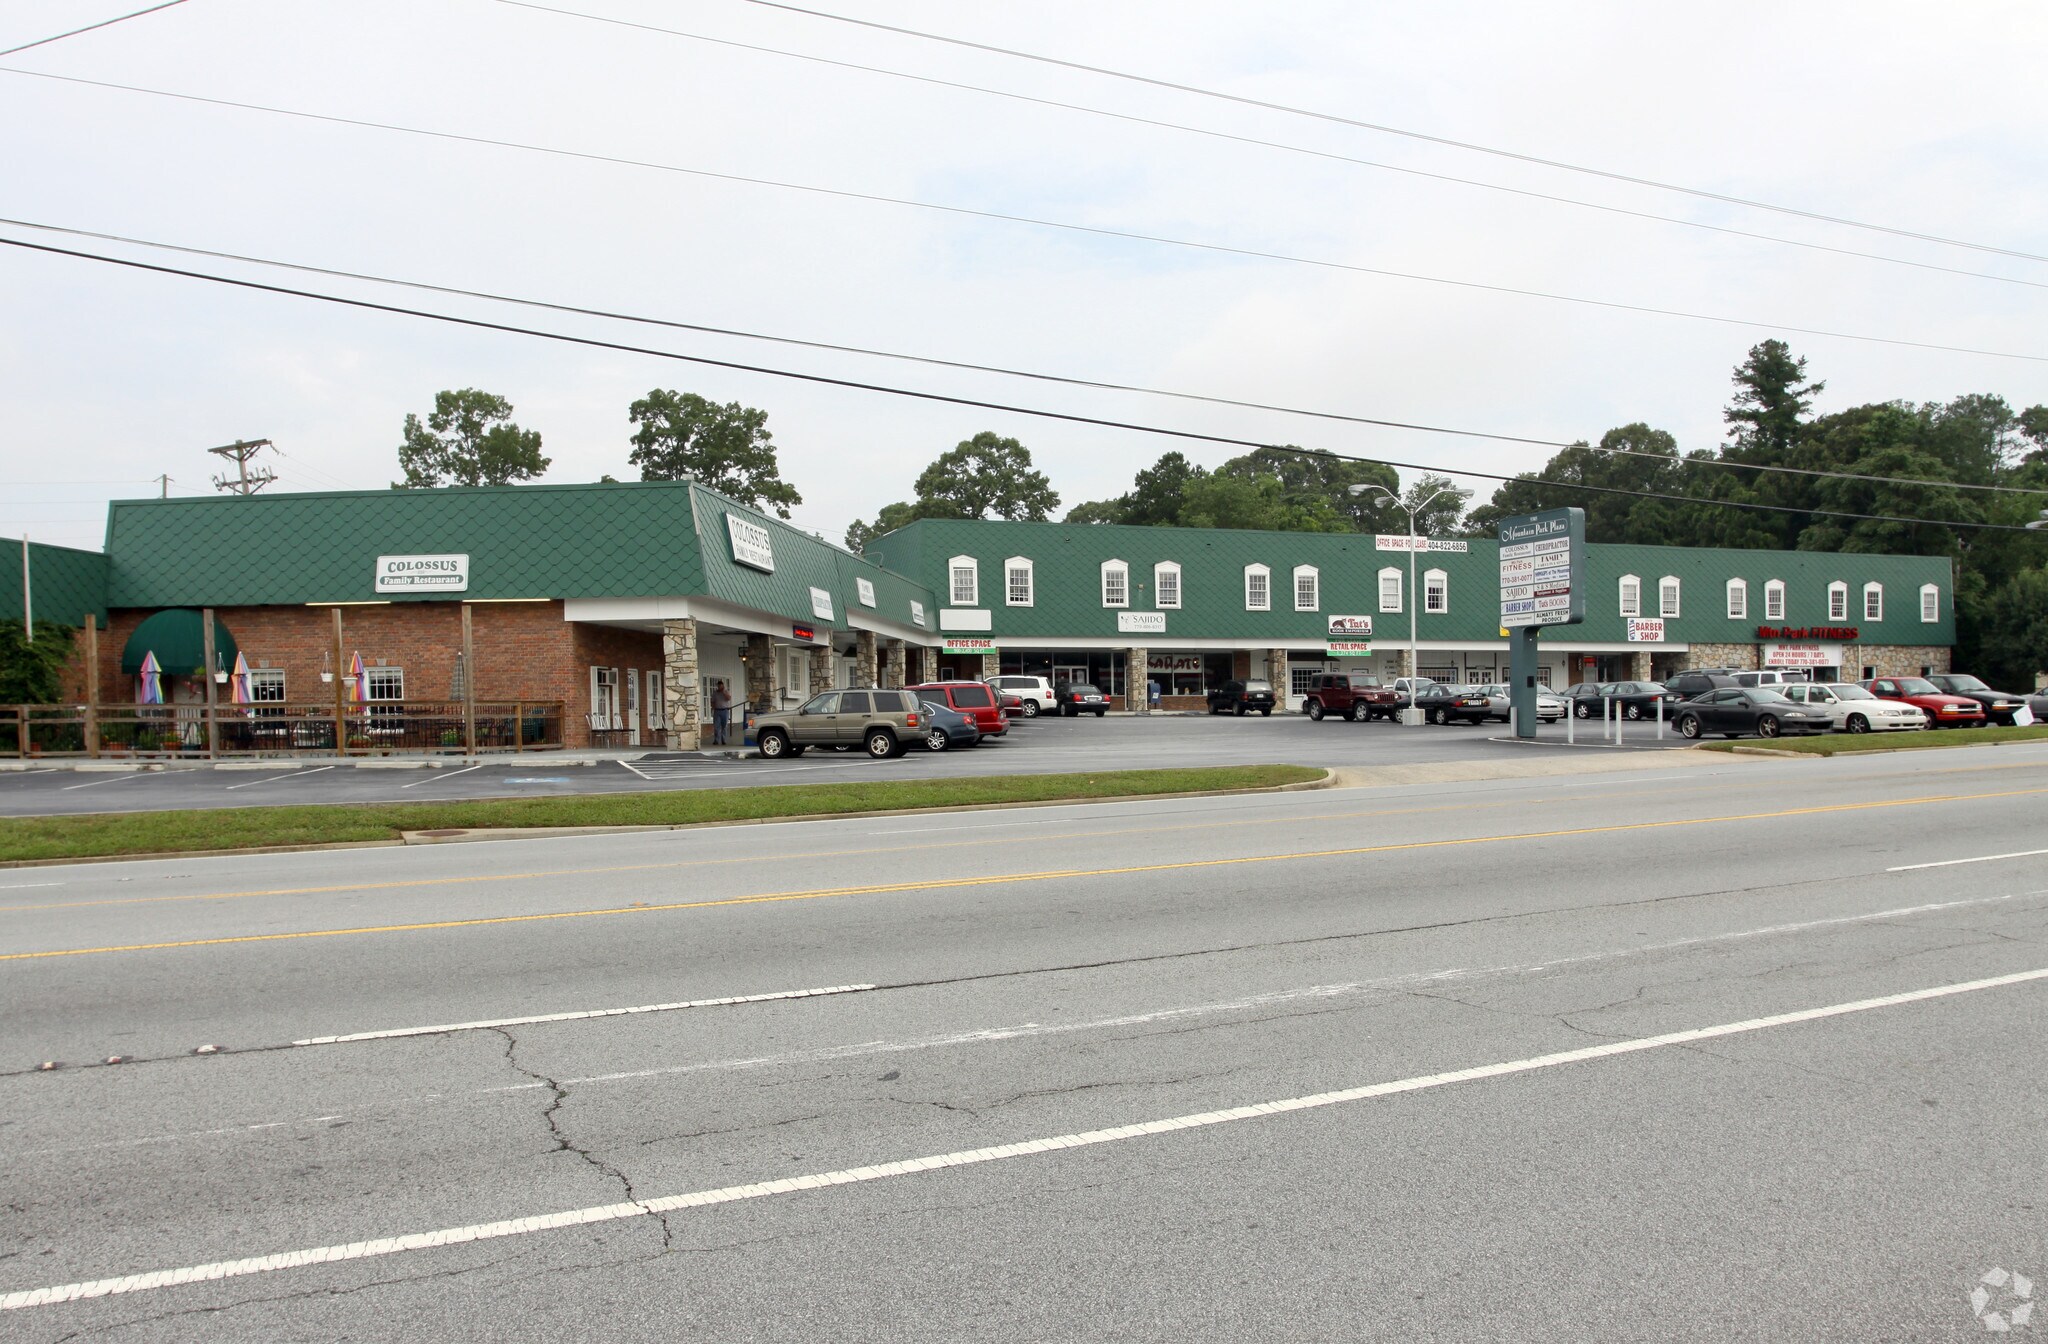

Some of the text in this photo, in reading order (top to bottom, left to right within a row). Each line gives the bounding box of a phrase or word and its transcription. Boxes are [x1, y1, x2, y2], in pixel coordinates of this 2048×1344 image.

[1536, 522, 1548, 536] Park
[731, 519, 770, 551] COLOSSUS
[1415, 540, 1427, 548] LEASE
[1428, 542, 1466, 550] 404-822-6856
[388, 561, 458, 572] COLOSSUS
[1502, 562, 1532, 572] FITNESS
[384, 576, 460, 586] Family Restaurant
[1506, 601, 1531, 612] BARBER SHOP
[1811, 627, 1858, 639] FITNESS
